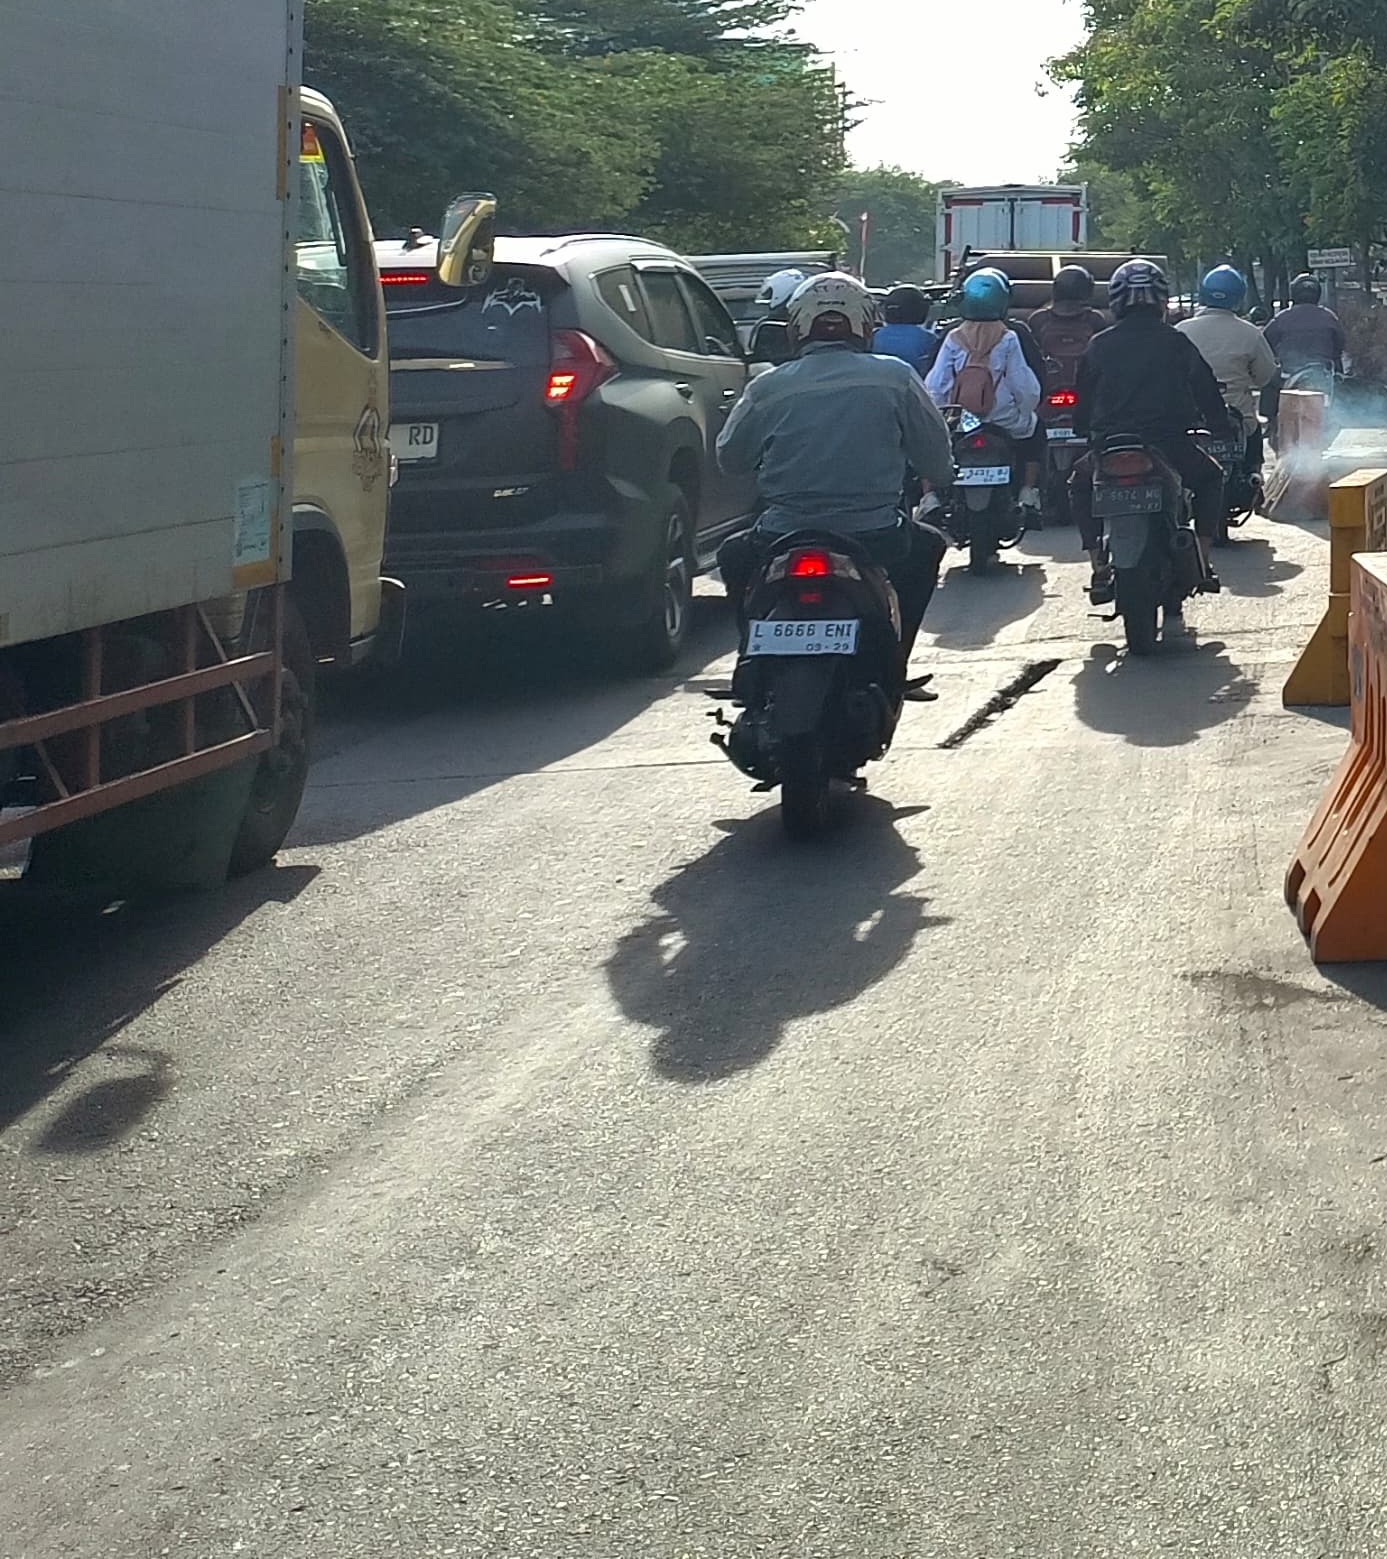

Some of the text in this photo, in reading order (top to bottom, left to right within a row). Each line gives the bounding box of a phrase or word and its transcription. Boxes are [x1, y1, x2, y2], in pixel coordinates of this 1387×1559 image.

[409, 426, 434, 446] RD
[754, 624, 764, 638] L
[824, 623, 853, 637] ENI
